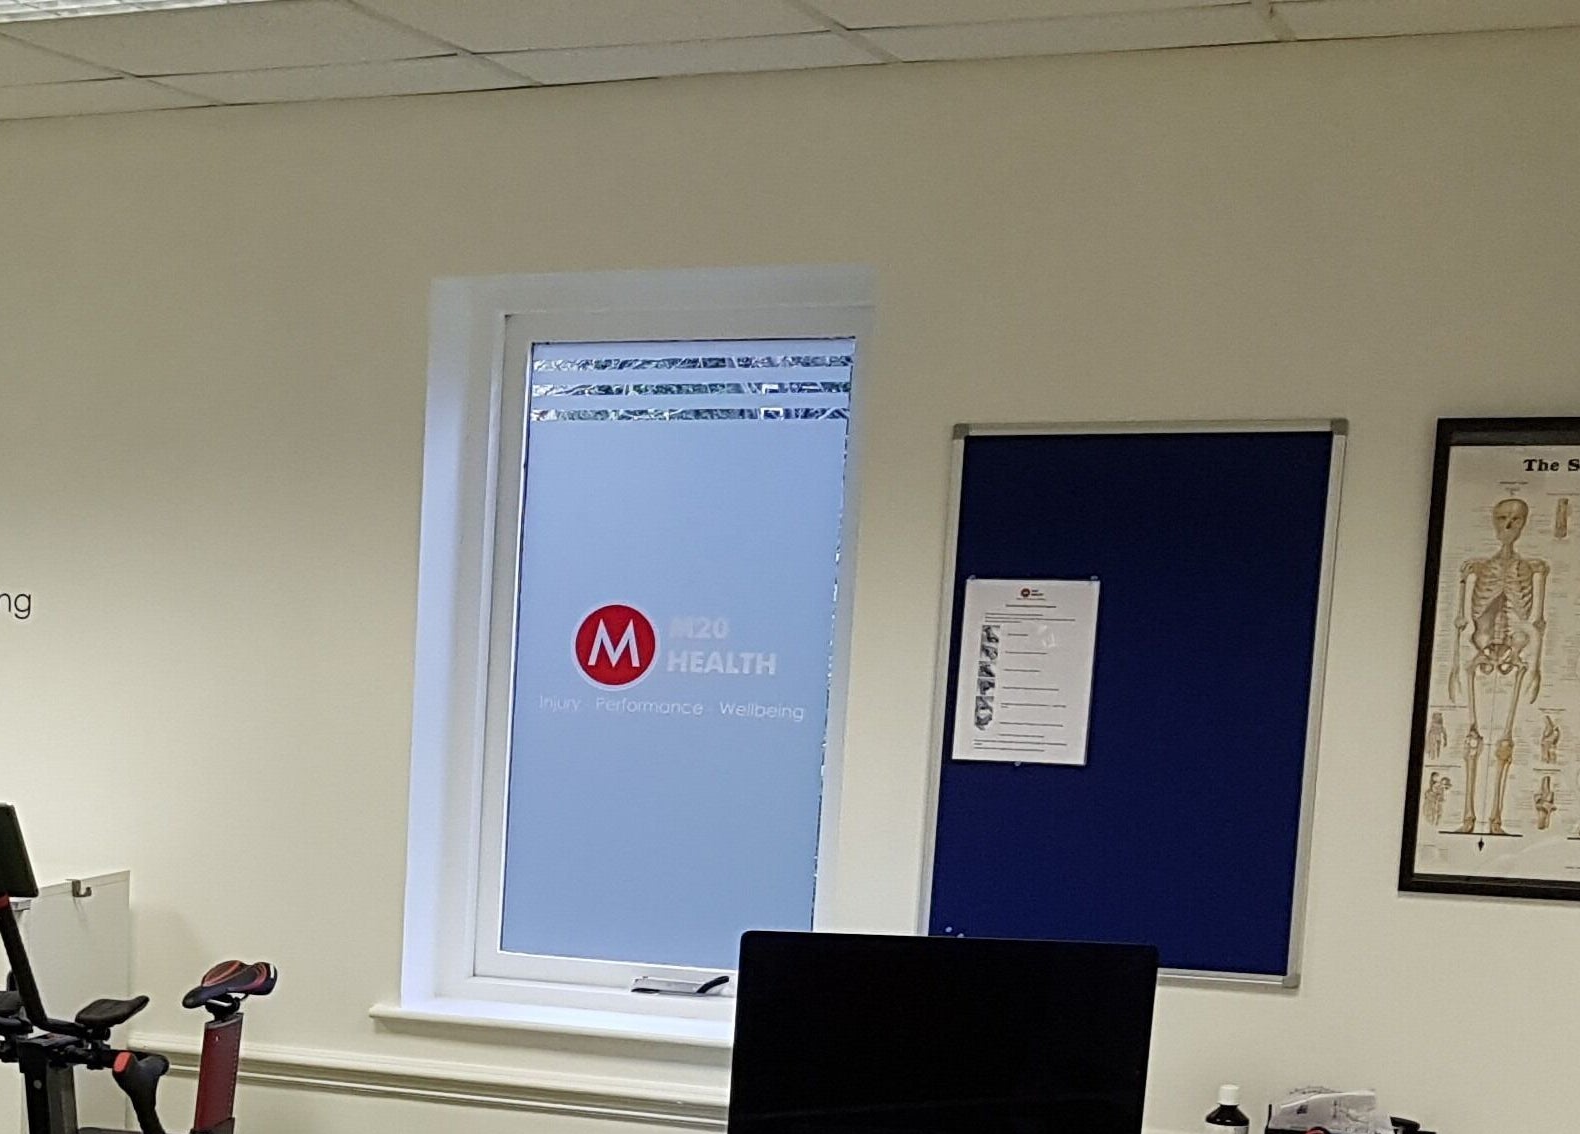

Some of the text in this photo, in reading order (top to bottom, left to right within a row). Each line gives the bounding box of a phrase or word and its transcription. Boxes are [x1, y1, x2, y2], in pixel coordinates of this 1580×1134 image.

[1523, 458, 1560, 472] The
[669, 616, 730, 640] M20
[587, 618, 641, 669] M
[666, 650, 777, 676] HEALTH
[538, 695, 805, 722] Injury Performance Wellbeing
